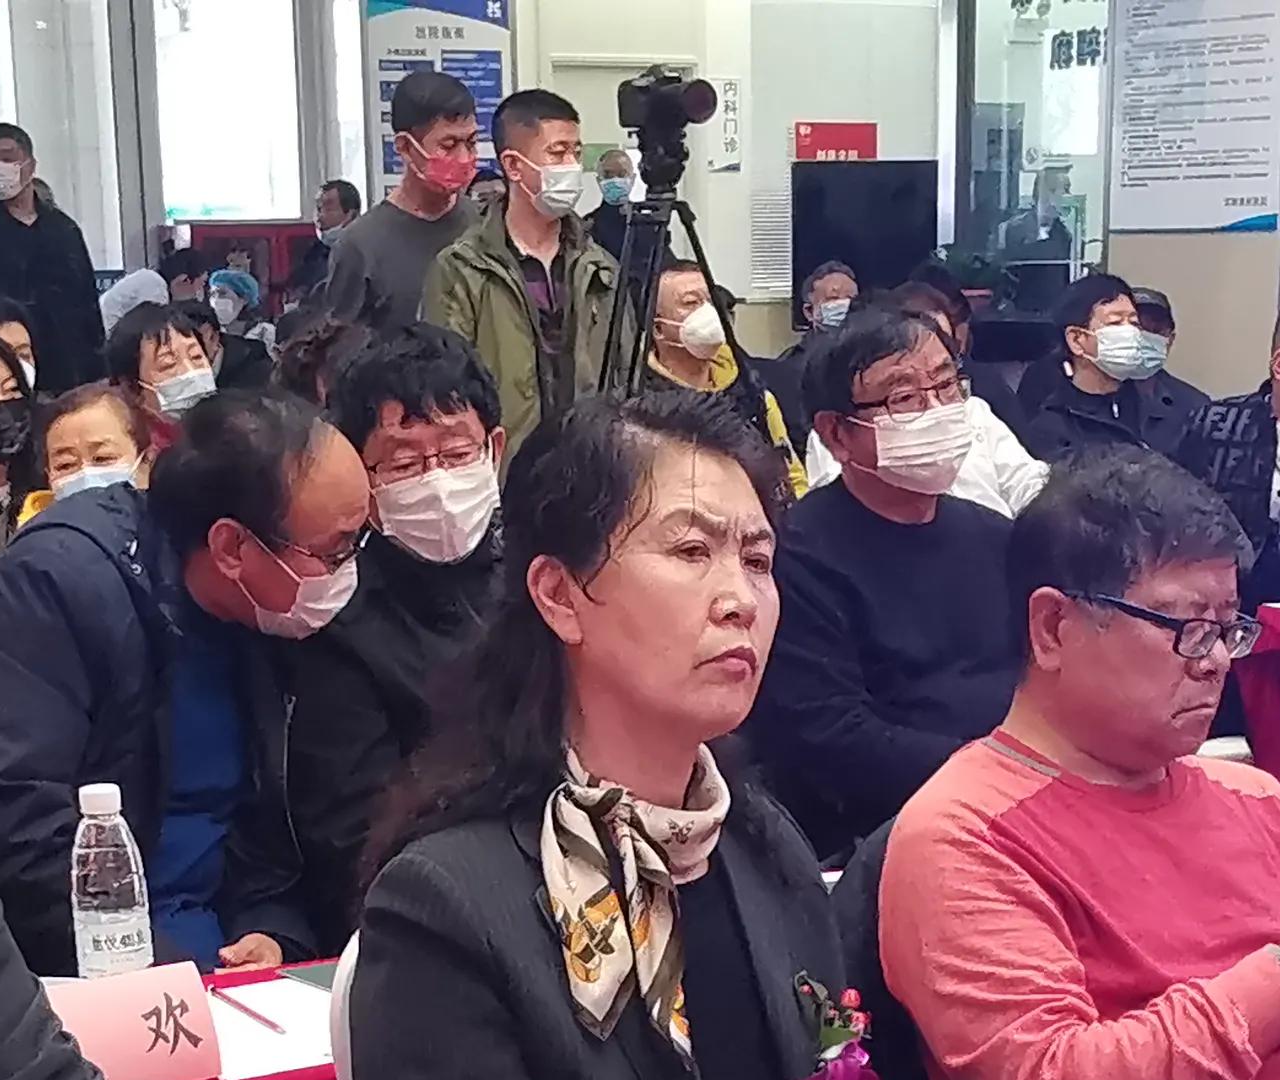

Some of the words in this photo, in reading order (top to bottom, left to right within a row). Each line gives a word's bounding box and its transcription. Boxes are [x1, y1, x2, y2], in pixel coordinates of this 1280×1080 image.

[723, 79, 738, 153] 内科门诊
[141, 992, 203, 1055] 欢
